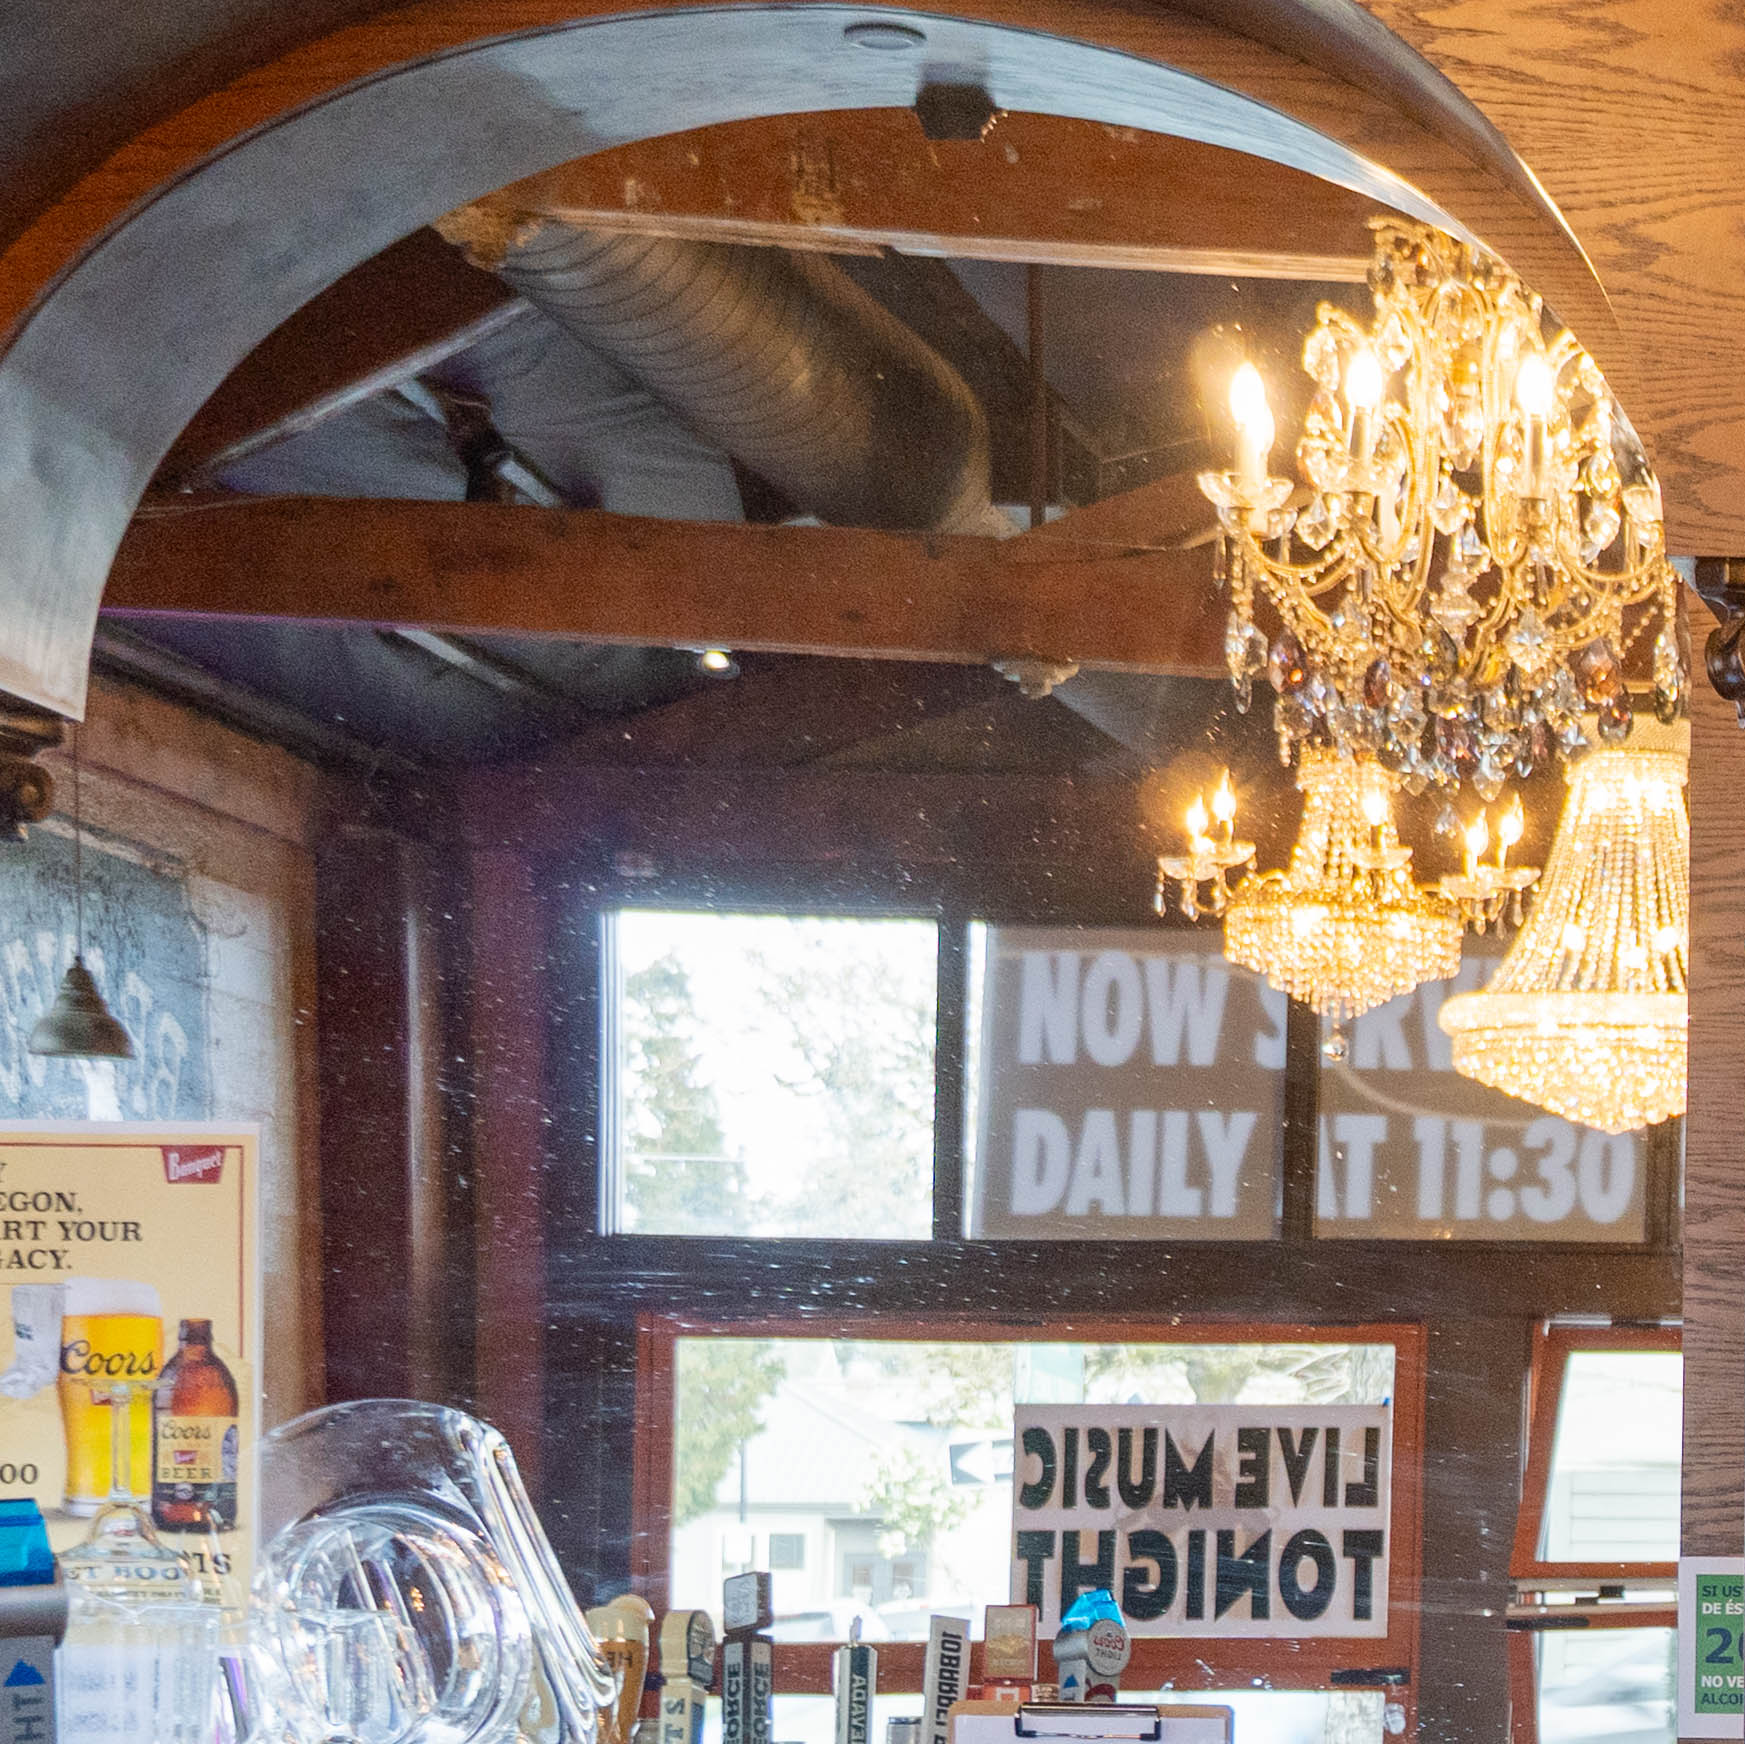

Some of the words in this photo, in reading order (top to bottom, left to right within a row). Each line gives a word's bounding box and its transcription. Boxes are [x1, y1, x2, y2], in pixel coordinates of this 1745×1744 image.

[1018, 950, 1231, 1068] NOW
[1011, 1110, 1257, 1219] DAILY
[1414, 1117, 1635, 1223] 11:30
[57, 1221, 143, 1242] YOUR
[61, 1339, 157, 1376] Coors
[161, 1420, 212, 1440] Coors
[161, 1467, 213, 1479] BEER
[1702, 1585, 1717, 1597] SI
[1702, 1603, 1721, 1615] DE
[1701, 1675, 1722, 1688] NO
